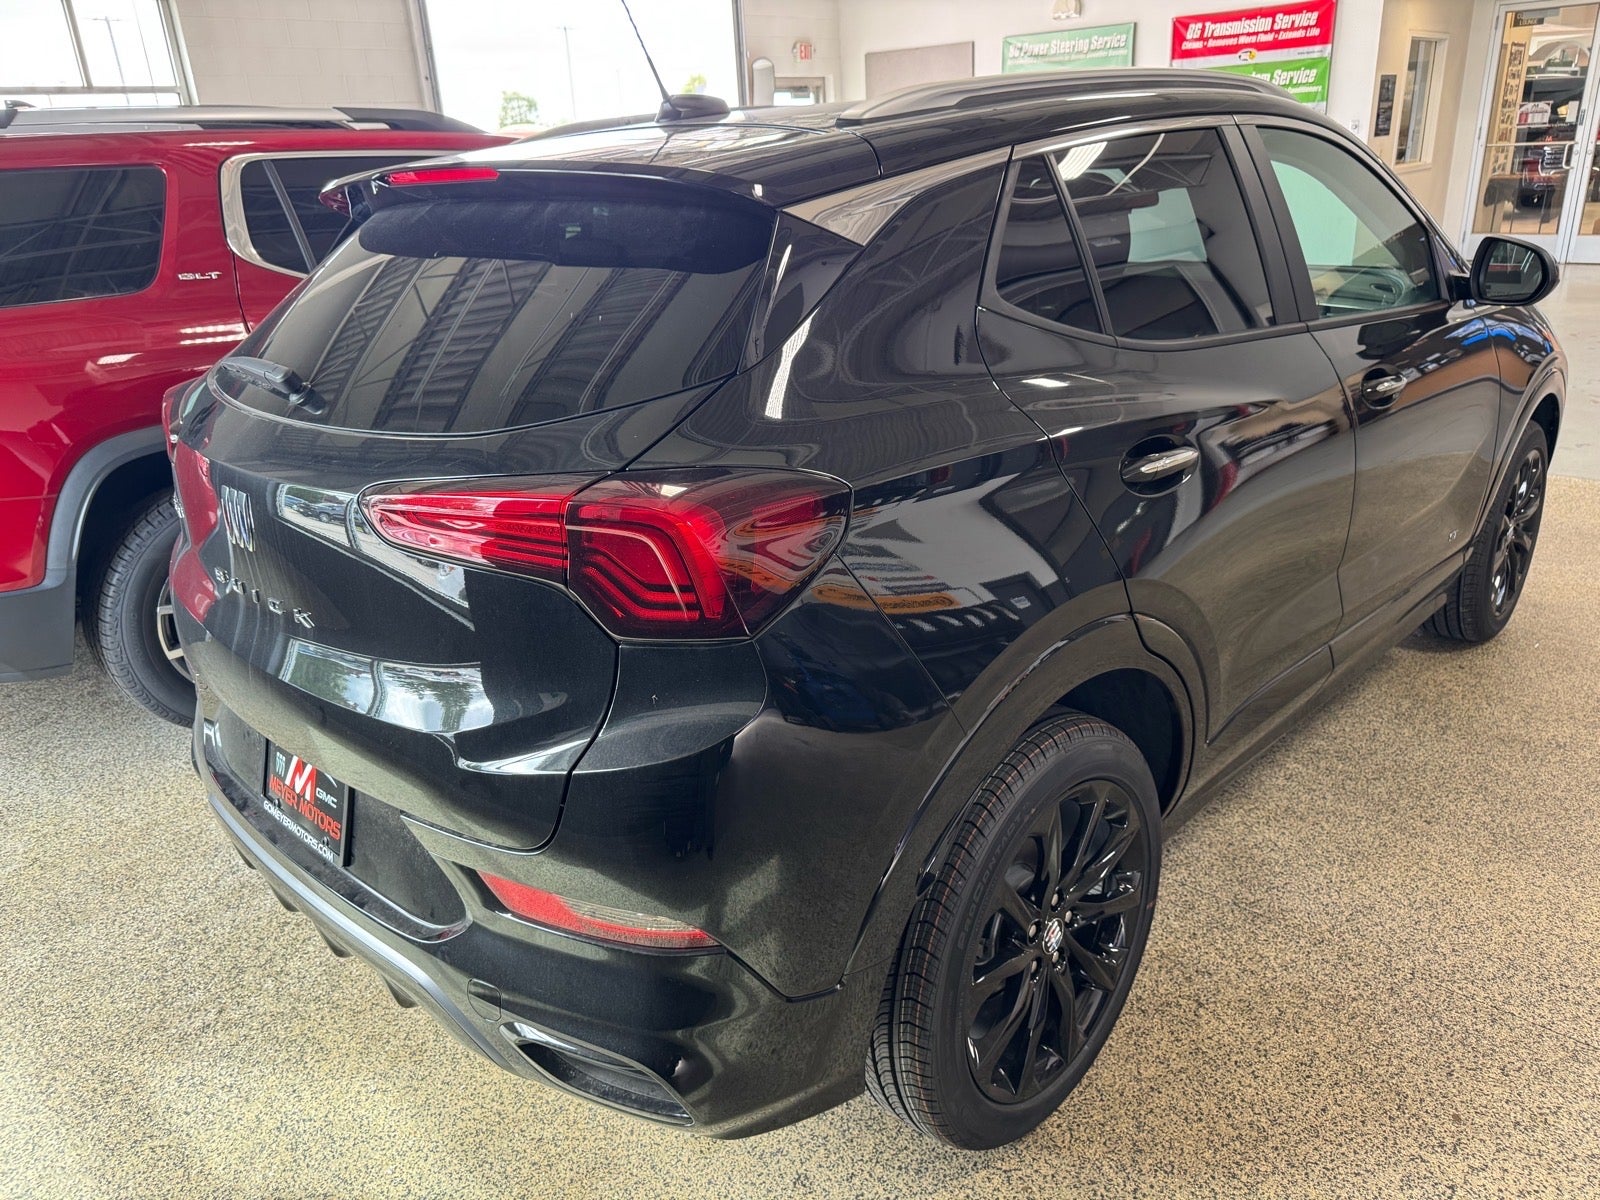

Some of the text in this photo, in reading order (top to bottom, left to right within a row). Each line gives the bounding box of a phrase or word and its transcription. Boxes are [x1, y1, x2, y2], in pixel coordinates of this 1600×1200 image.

[1203, 16, 1272, 39] Transmission
[1274, 10, 1319, 29] Service
[1206, 37, 1238, 48] Removes
[1257, 32, 1275, 43] Fluid
[1277, 28, 1306, 40] Extends
[1307, 27, 1320, 37] Life
[1021, 42, 1049, 57] Power
[1050, 36, 1089, 55] Steering
[1090, 32, 1127, 50] Service
[1271, 67, 1317, 86] Service
[214, 566, 315, 629] BUICK
[269, 774, 341, 841] MEYER MOTORS
[316, 787, 338, 808] GMC
[263, 800, 334, 863] GOMEYERMOTORS.COM
